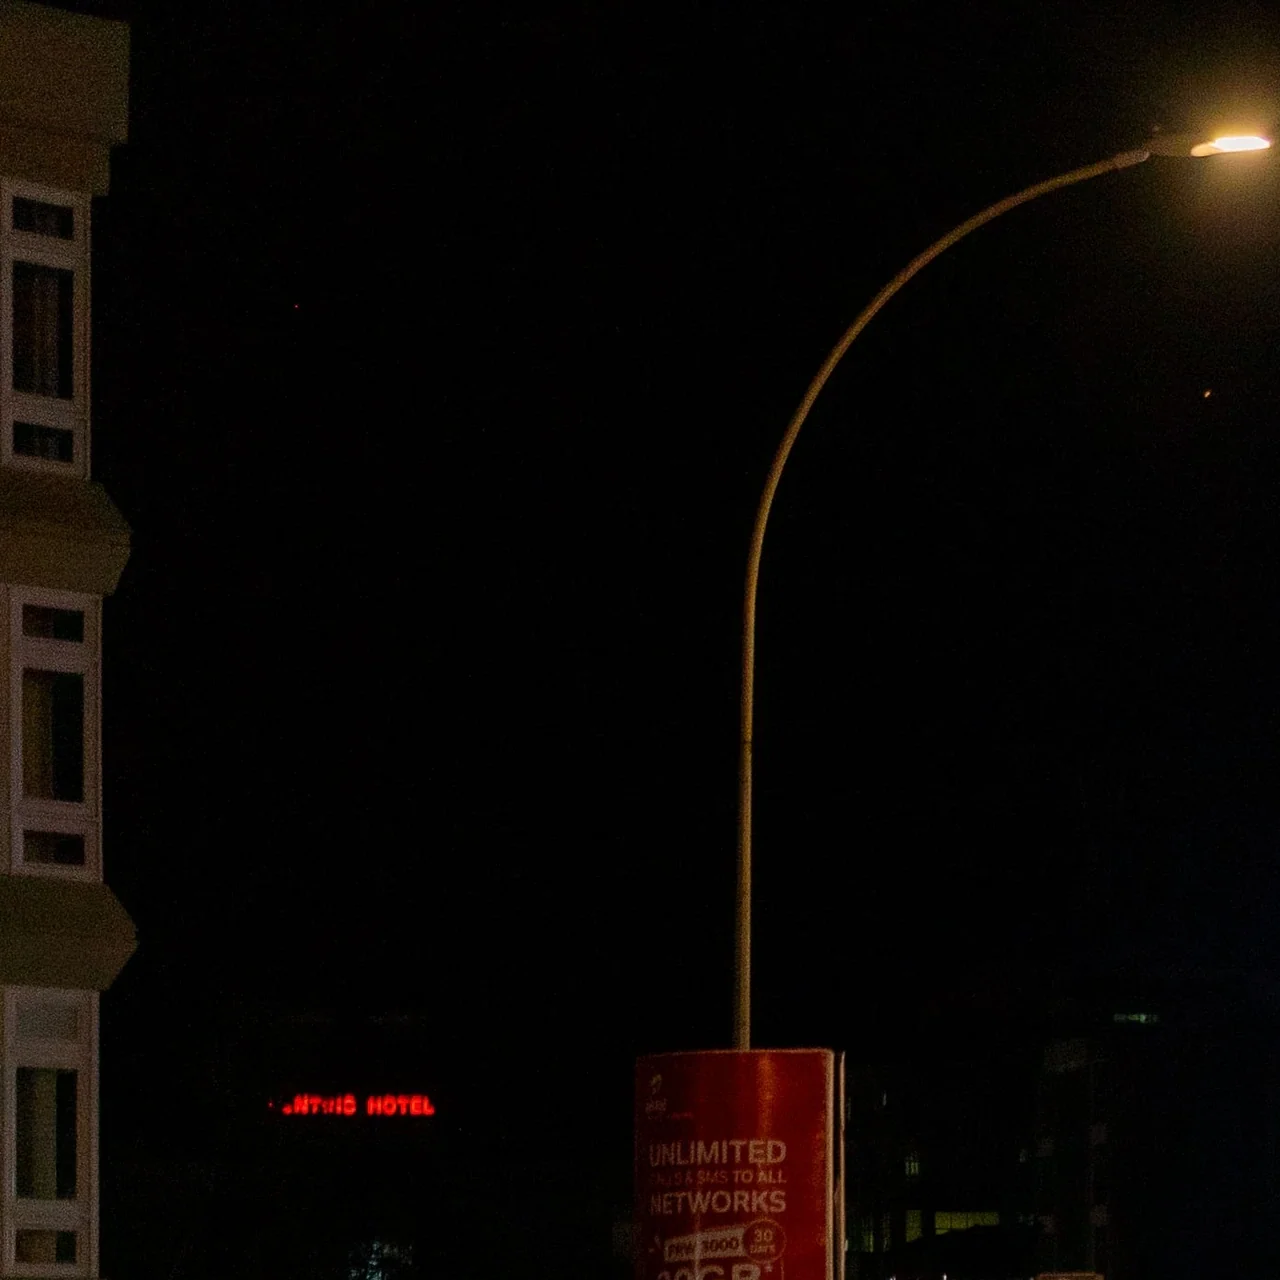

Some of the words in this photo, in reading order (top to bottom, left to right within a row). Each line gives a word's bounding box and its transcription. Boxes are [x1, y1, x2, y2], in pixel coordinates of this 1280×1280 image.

[366, 1094, 436, 1116] HOTEL
[650, 1140, 788, 1167] UNLIMITED
[732, 1169, 755, 1184] TO
[757, 1169, 788, 1184] ALL
[650, 1190, 788, 1217] NETWORKS
